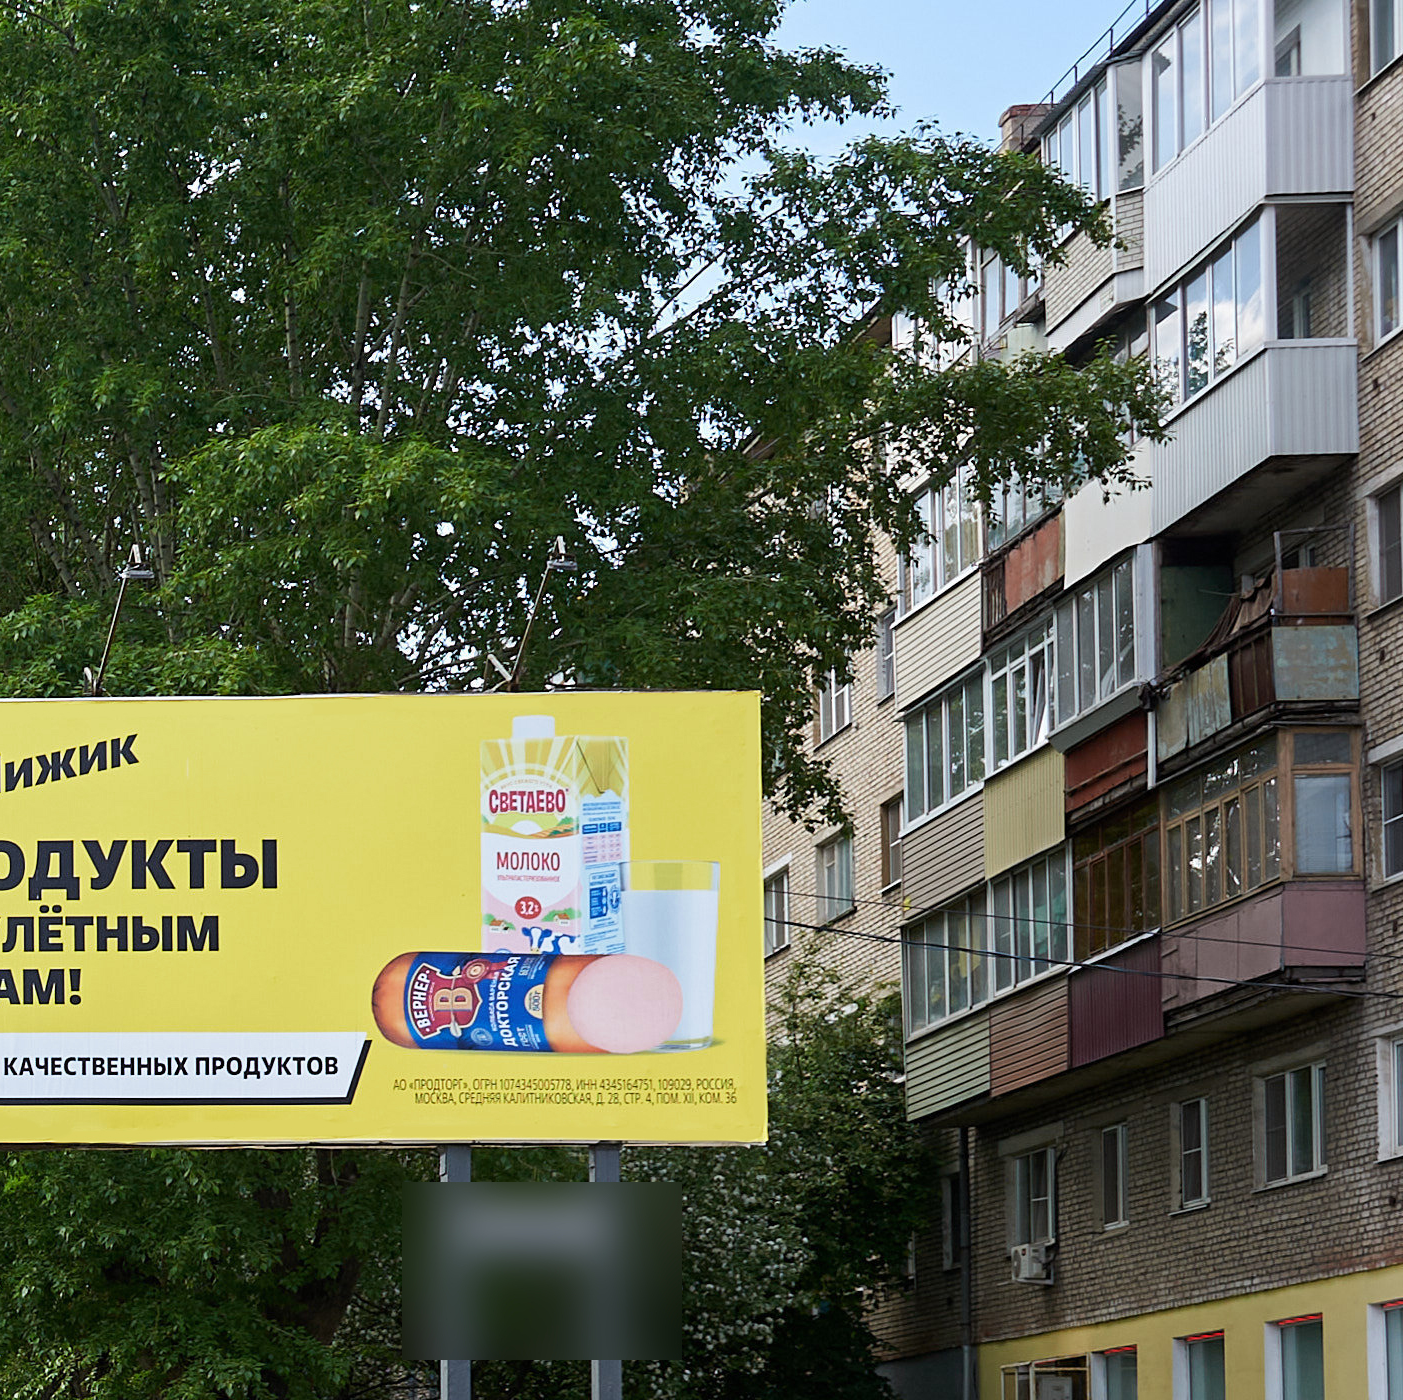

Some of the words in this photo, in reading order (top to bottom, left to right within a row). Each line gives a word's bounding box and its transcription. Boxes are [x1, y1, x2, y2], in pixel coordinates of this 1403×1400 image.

[488, 789, 566, 814] СВЕТАЕВО
[496, 851, 561, 872] МОЛОКО
[412, 971, 432, 1029] ВЕРНЕР
[495, 956, 521, 1047] ДОКТОРСКАЯ
[3, 1056, 189, 1077] КАЧЕСТВЕННЫХ
[195, 1056, 340, 1081] ПРОДУКТОВ
[393, 1079, 407, 1090] АО
[472, 1079, 497, 1090] ОГРН
[576, 1079, 597, 1090] ИНН
[658, 1079, 694, 1092] 109029,
[696, 1079, 737, 1092] РОССИЯ,
[414, 1092, 457, 1105] МОСКВА,
[458, 1092, 501, 1105] СРЕДНЯЯ
[607, 1093, 622, 1106] 28,
[623, 1093, 643, 1104] СТР.
[656, 1093, 682, 1104] ПОМ.
[699, 1093, 723, 1104] КОМ.
[725, 1093, 737, 1104] 36
